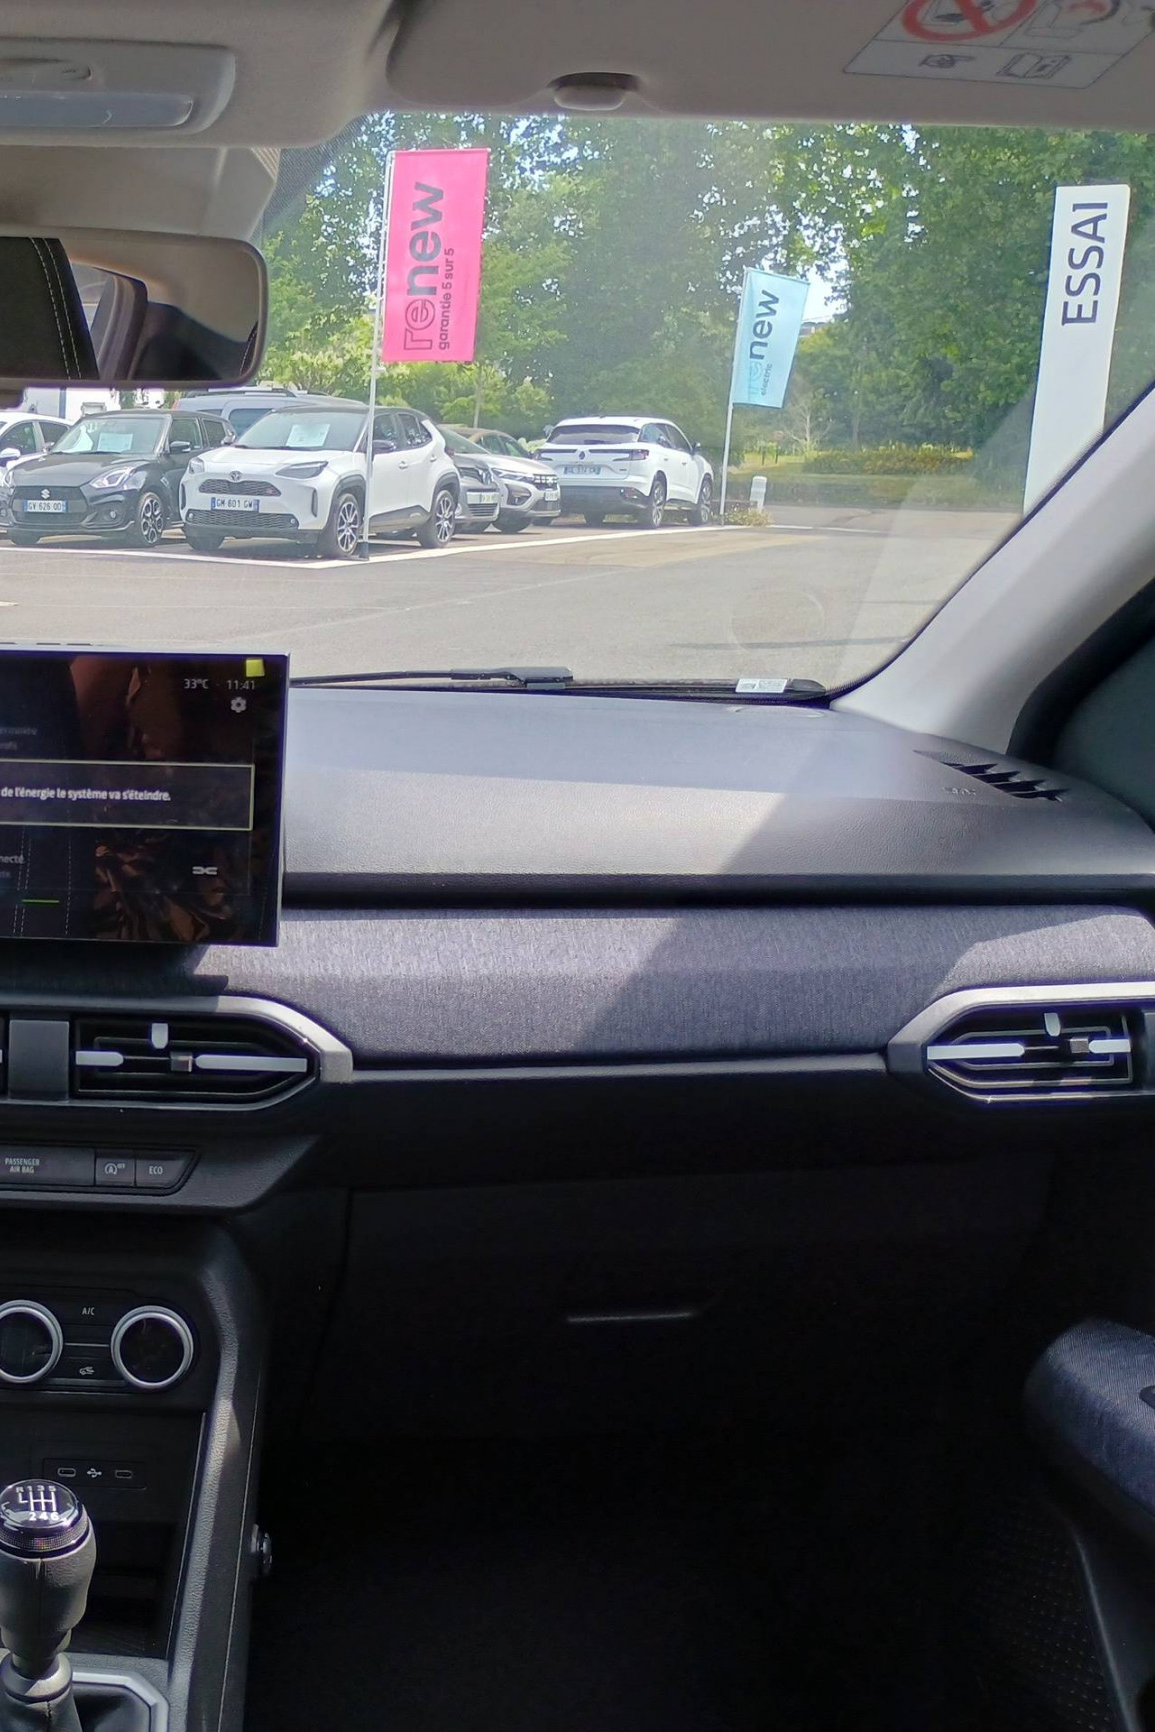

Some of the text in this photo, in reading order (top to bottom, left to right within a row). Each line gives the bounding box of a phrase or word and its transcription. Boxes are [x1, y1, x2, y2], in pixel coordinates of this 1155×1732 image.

[404, 182, 444, 350] renew
[1061, 202, 1108, 326] ESSAI
[438, 247, 455, 350] garantie 5 sur 5
[761, 363, 773, 396] electric
[183, 678, 255, 690] 33°C 11:41
[0, 787, 14, 797] de
[14, 786, 55, 799] l'énergie
[57, 787, 66, 798] le
[67, 788, 107, 801] système
[109, 791, 121, 800] va
[122, 789, 171, 801] s'éteindre.
[5, 1158, 40, 1166] PASSENGER
[21, 1166, 35, 1174] BAG
[149, 1166, 163, 1175] ECO
[81, 1306, 95, 1316] A/C
[29, 1511, 60, 1521] 2 4 6
